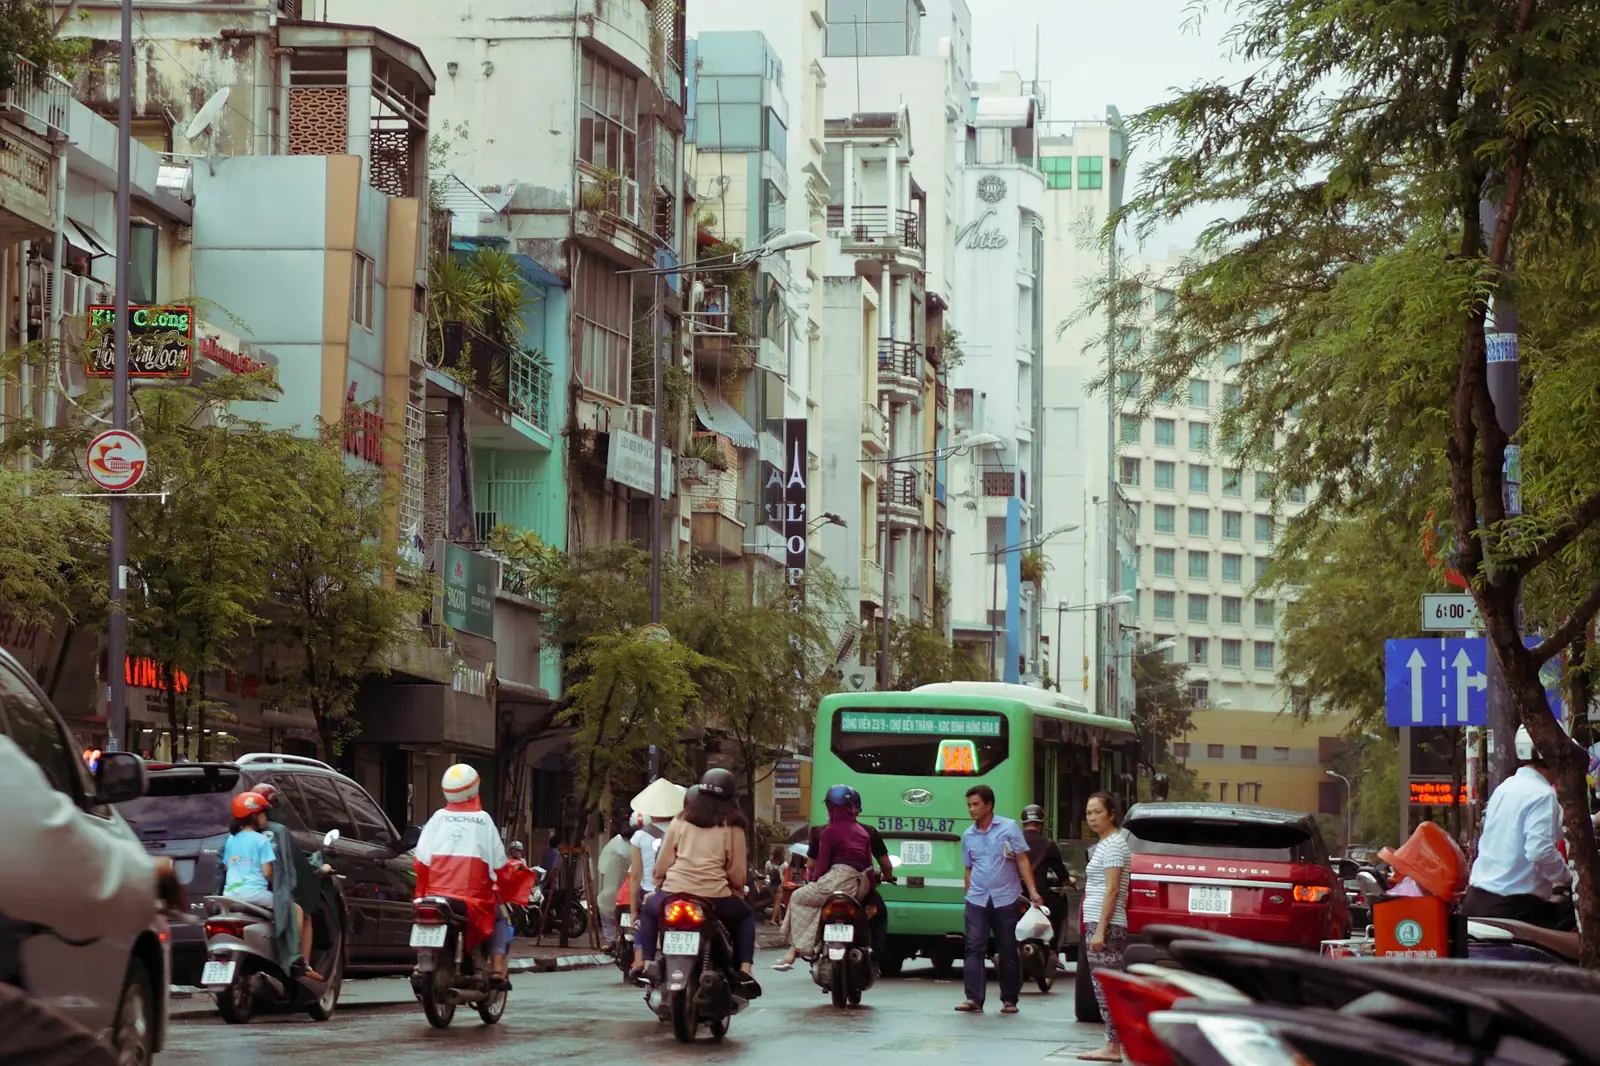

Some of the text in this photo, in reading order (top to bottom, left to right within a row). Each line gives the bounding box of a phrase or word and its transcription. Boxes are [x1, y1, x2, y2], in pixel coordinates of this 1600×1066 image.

[1435, 603, 1465, 619] 6:00
[878, 816, 955, 832] 51B-194.87
[908, 844, 924, 853] 51B
[1153, 863, 1270, 875] RANGE ROVER
